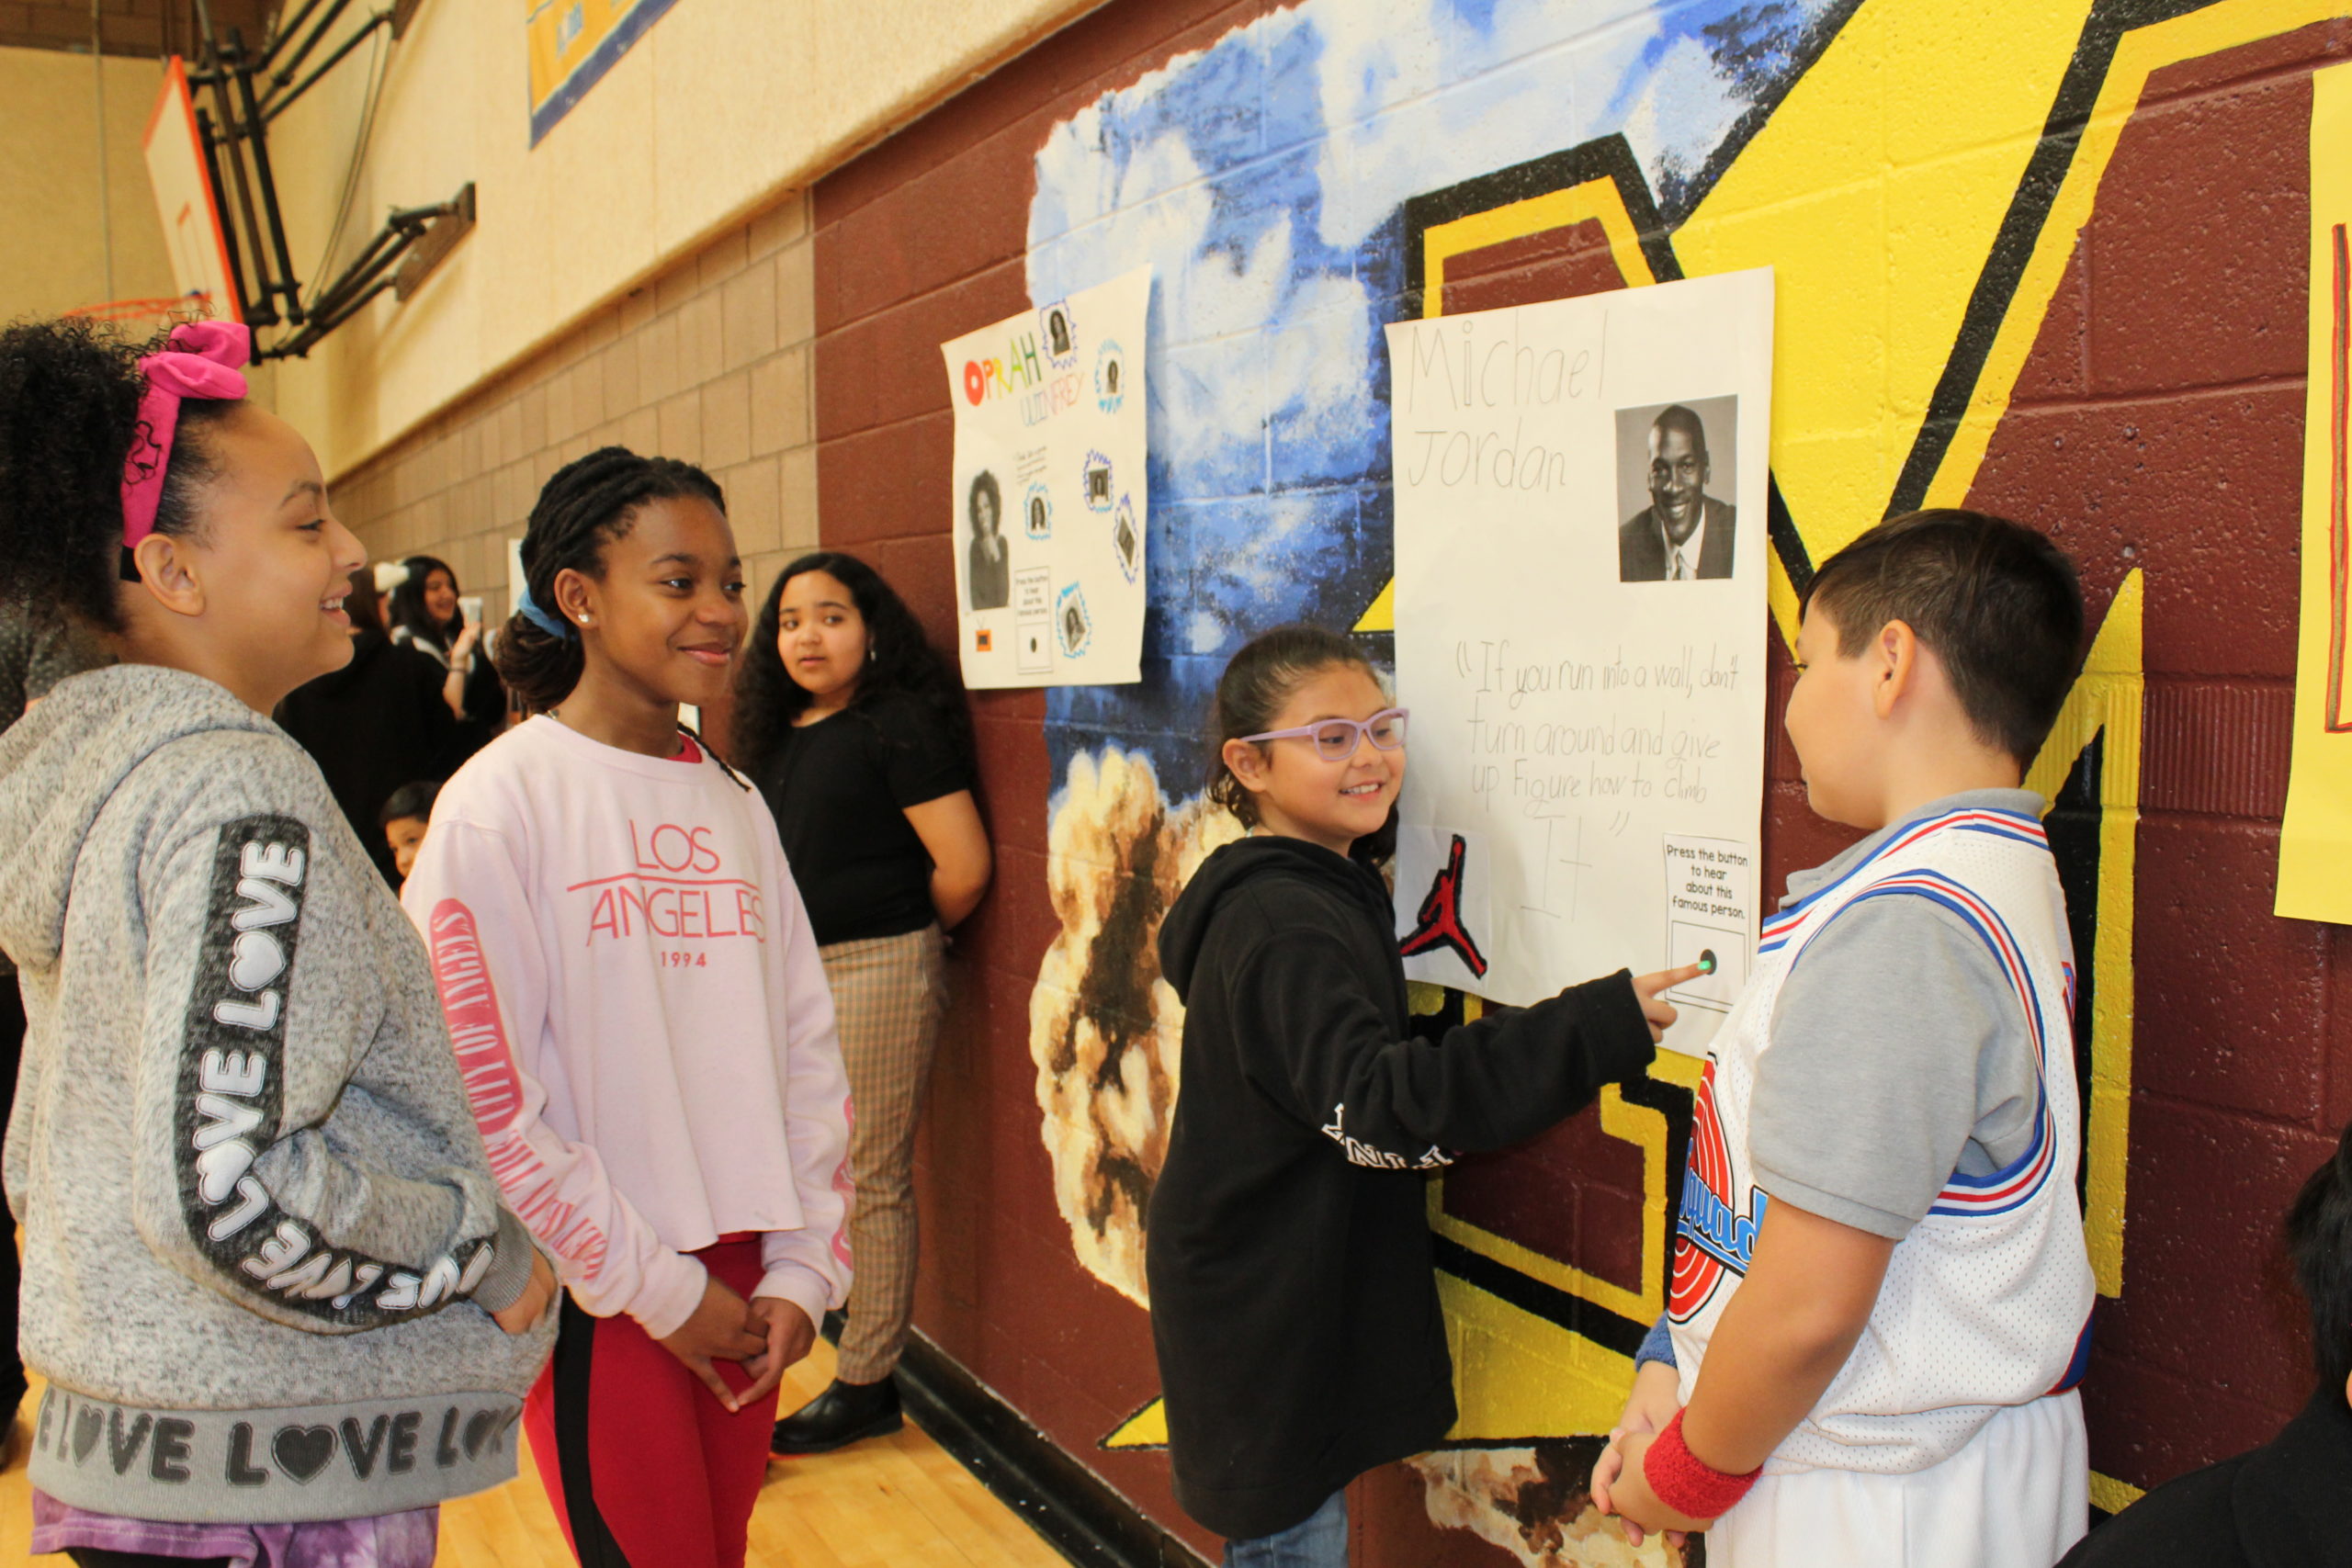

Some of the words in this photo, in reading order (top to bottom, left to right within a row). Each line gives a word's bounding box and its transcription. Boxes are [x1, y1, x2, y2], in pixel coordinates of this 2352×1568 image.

[963, 332, 1042, 407] OPRAH
[1408, 309, 1609, 412] Michael
[1408, 415, 1566, 493] Jordan
[1509, 668, 1551, 709] you
[1558, 660, 1594, 690] run
[1603, 644, 1630, 690] into
[1634, 664, 1647, 687] a
[1533, 714, 1616, 756] around
[1622, 710, 1662, 754] and
[1670, 718, 1722, 770] give
[1472, 763, 1499, 814] up
[1589, 761, 1624, 799] how
[1631, 762, 1652, 799] to
[1664, 765, 1708, 805] climb
[628, 818, 720, 874] LOS
[1667, 844, 1695, 860] Press
[1698, 848, 1715, 863] the
[1717, 850, 1748, 867] button
[1691, 864, 1702, 877] to
[1704, 864, 1727, 881] hear
[1672, 896, 1709, 913] famous
[1711, 902, 1746, 920] person.
[1686, 881, 1713, 897] about
[1716, 885, 1733, 899] this
[433, 911, 489, 1010] ANGELS
[661, 951, 707, 967] 1994
[450, 1020, 498, 1056] OF
